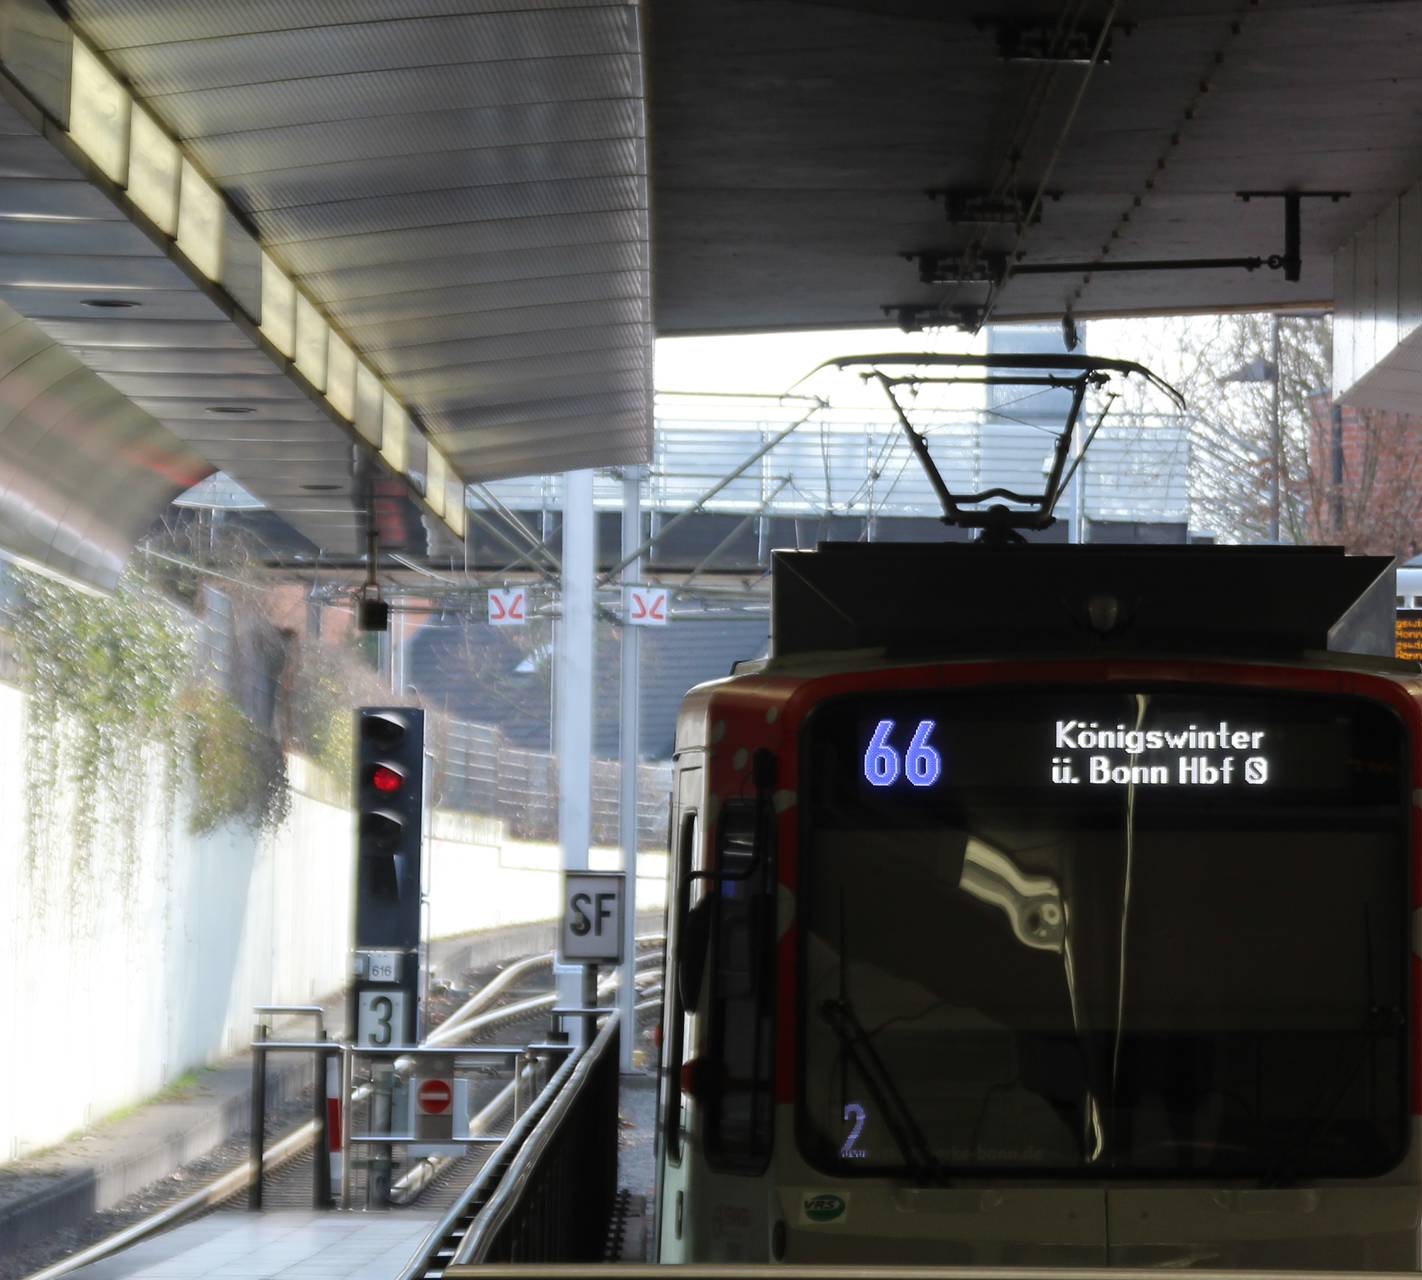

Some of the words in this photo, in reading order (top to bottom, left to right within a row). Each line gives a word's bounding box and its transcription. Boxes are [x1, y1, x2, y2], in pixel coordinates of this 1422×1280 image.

[863, 719, 943, 787] 66
[1055, 720, 1265, 755] Königswinter
[1053, 756, 1080, 786] ü.
[1090, 756, 1168, 786] Bonn
[1178, 756, 1233, 786] Hbf
[568, 891, 616, 938] SF
[367, 995, 393, 1047] 3
[841, 1103, 870, 1159] 2
[803, 1199, 836, 1210] VRS
